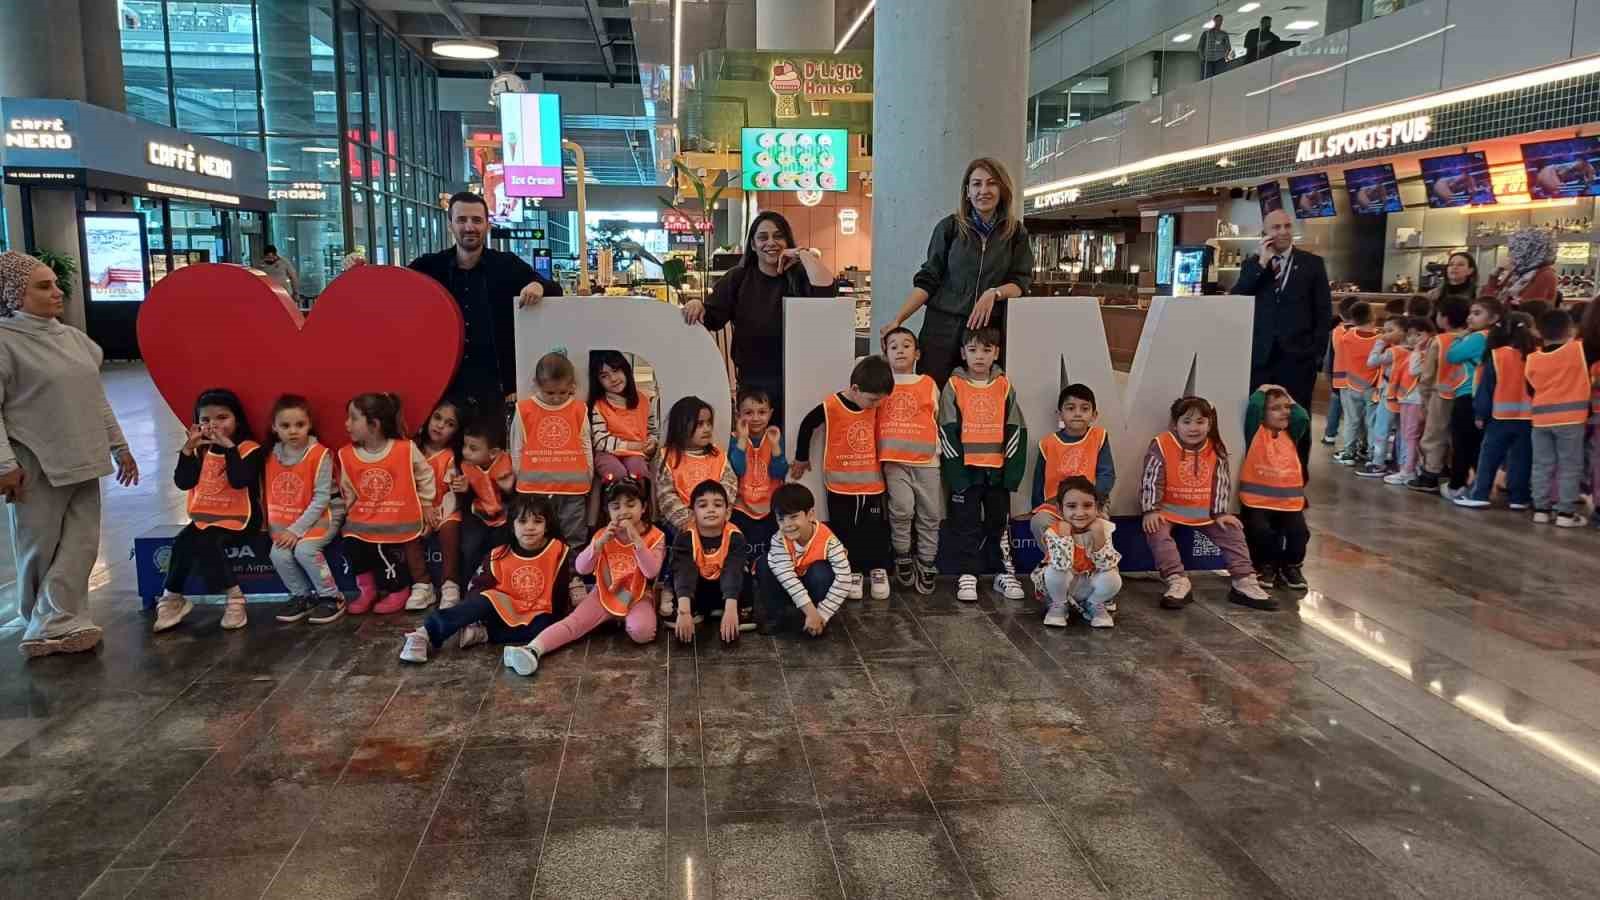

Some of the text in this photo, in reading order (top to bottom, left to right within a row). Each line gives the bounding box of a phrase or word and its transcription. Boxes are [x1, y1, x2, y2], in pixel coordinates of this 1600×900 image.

[804, 81, 853, 95] House
[6, 133, 72, 149] NERO
[1296, 116, 1431, 162] ALL SPORTS PUB
[198, 153, 233, 180] NERO
[527, 175, 555, 186] Cream
